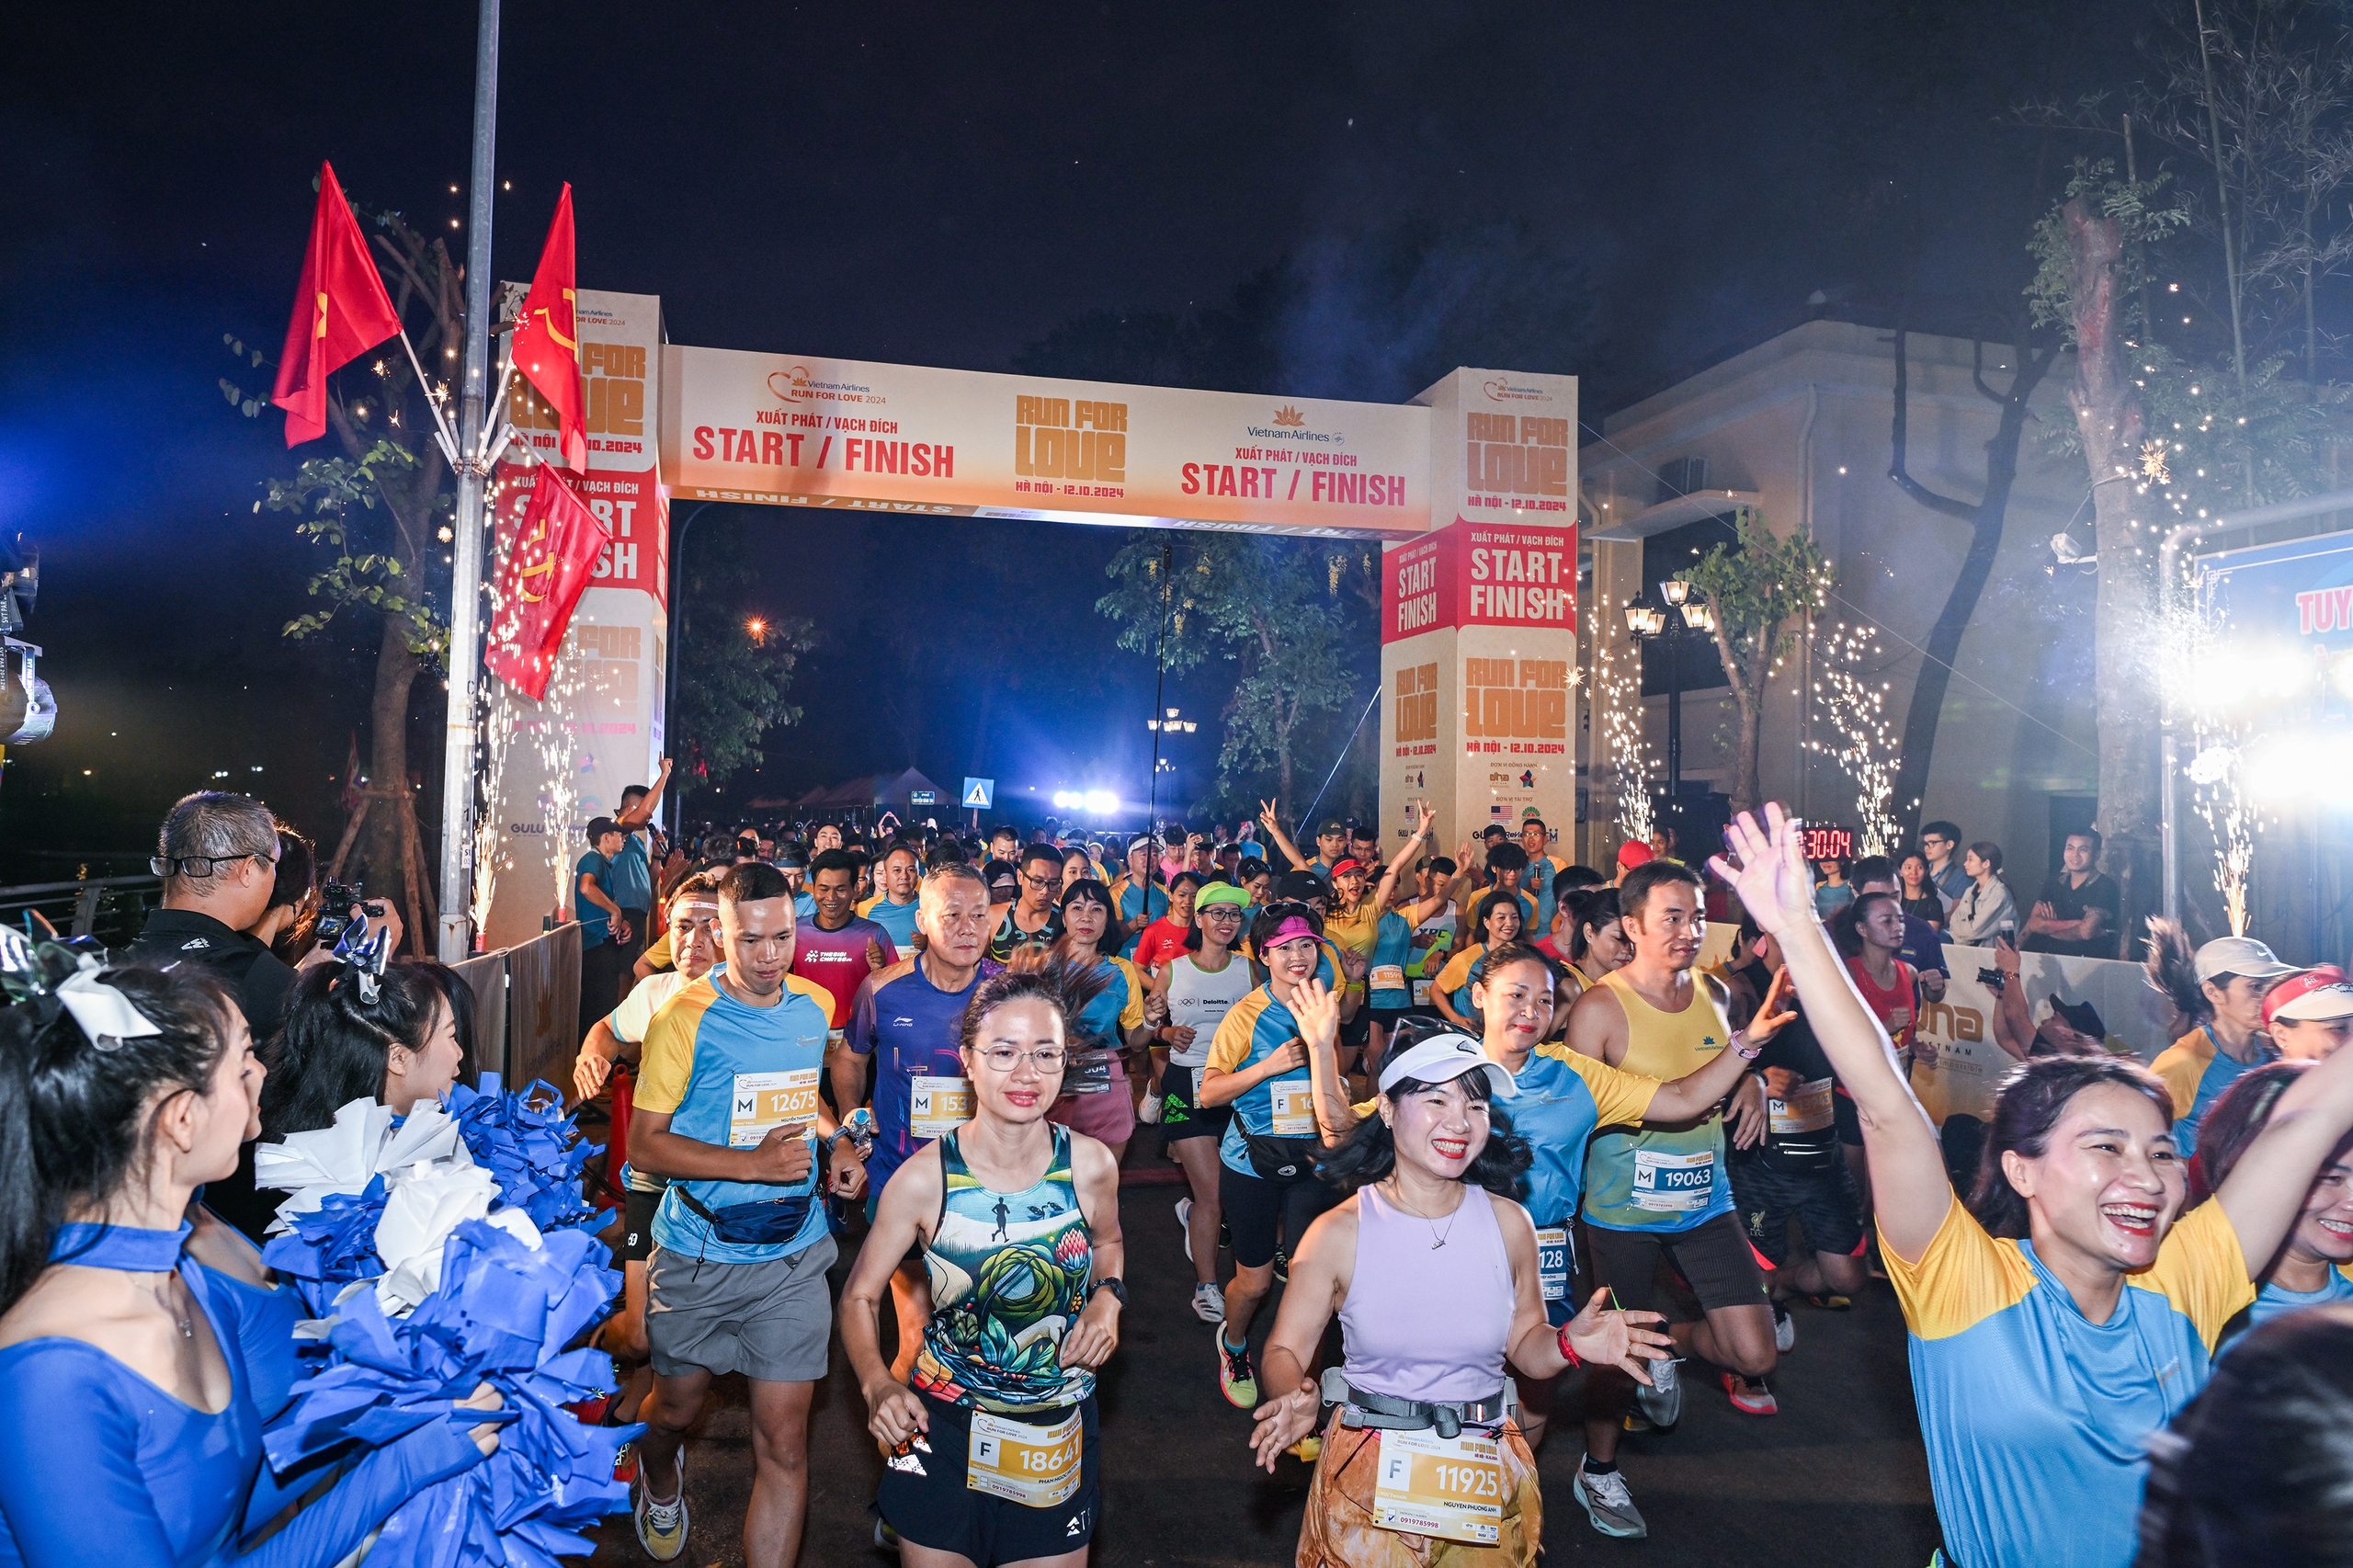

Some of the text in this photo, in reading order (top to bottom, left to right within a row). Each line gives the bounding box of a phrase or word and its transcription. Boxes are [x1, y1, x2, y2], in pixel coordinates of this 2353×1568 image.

[583, 342, 646, 379] FOR
[791, 389, 886, 405] RUN FOR LOVE 2024
[841, 383, 870, 393] Airlines
[756, 408, 898, 434] XUẤT PHÁT VẠCH ĐÍCH
[1016, 395, 1128, 432] RUN FOR
[1247, 426, 1290, 440] Vietnam
[1290, 430, 1330, 443] Airlines
[1467, 412, 1569, 447] RUN FOR
[587, 439, 642, 454] 10.2024
[693, 426, 954, 478] START / FINISH
[1015, 425, 1126, 483] LOVE
[1235, 445, 1357, 467] XUẤT PHÁT VẠCH ĐÍCH
[1467, 442, 1567, 496] LOVE
[514, 473, 537, 488] XUẤ
[583, 481, 611, 494] VẠCH
[614, 481, 639, 494] ĐÍCH
[1015, 479, 1031, 493] HÀ
[1063, 484, 1125, 499] 12.10.2024
[1181, 462, 1405, 506] START / FINISH
[696, 489, 954, 514] START FINISH
[1468, 494, 1482, 506] HÀ
[1511, 499, 1567, 511] 12.10.2024
[514, 494, 637, 537] SRT
[1173, 520, 1275, 533] FINISH
[1471, 530, 1564, 547] XUẤT PHÁT VẠCH ĐÍCH
[1471, 548, 1563, 584] START
[1398, 557, 1437, 598] START
[1398, 592, 1437, 633] FINISH
[1471, 585, 1563, 620] FINISH
[578, 625, 641, 659] FOR
[1397, 662, 1438, 697] RUN FOR
[1466, 658, 1567, 689] RUN FOR
[1466, 687, 1566, 739] LOVE
[1467, 740, 1480, 752] HÀ
[1510, 743, 1565, 754] 12.10.2024
[511, 823, 545, 834] GULU
[1472, 831, 1484, 839] GU
[738, 1090, 816, 1113] M 12675
[915, 1096, 968, 1112] M 153
[1278, 1099, 1284, 1109] F
[1773, 1101, 1785, 1111] M
[1638, 1168, 1711, 1187] M 19063
[1540, 1250, 1563, 1268] 128
[1047, 1428, 1062, 1439] RUN
[980, 1434, 1080, 1471] F 18641
[1460, 1441, 1474, 1452] RUN
[1389, 1459, 1497, 1497] F 11925
[992, 1484, 1027, 1499] 0919785998
[1400, 1517, 1439, 1528] 0919785998
